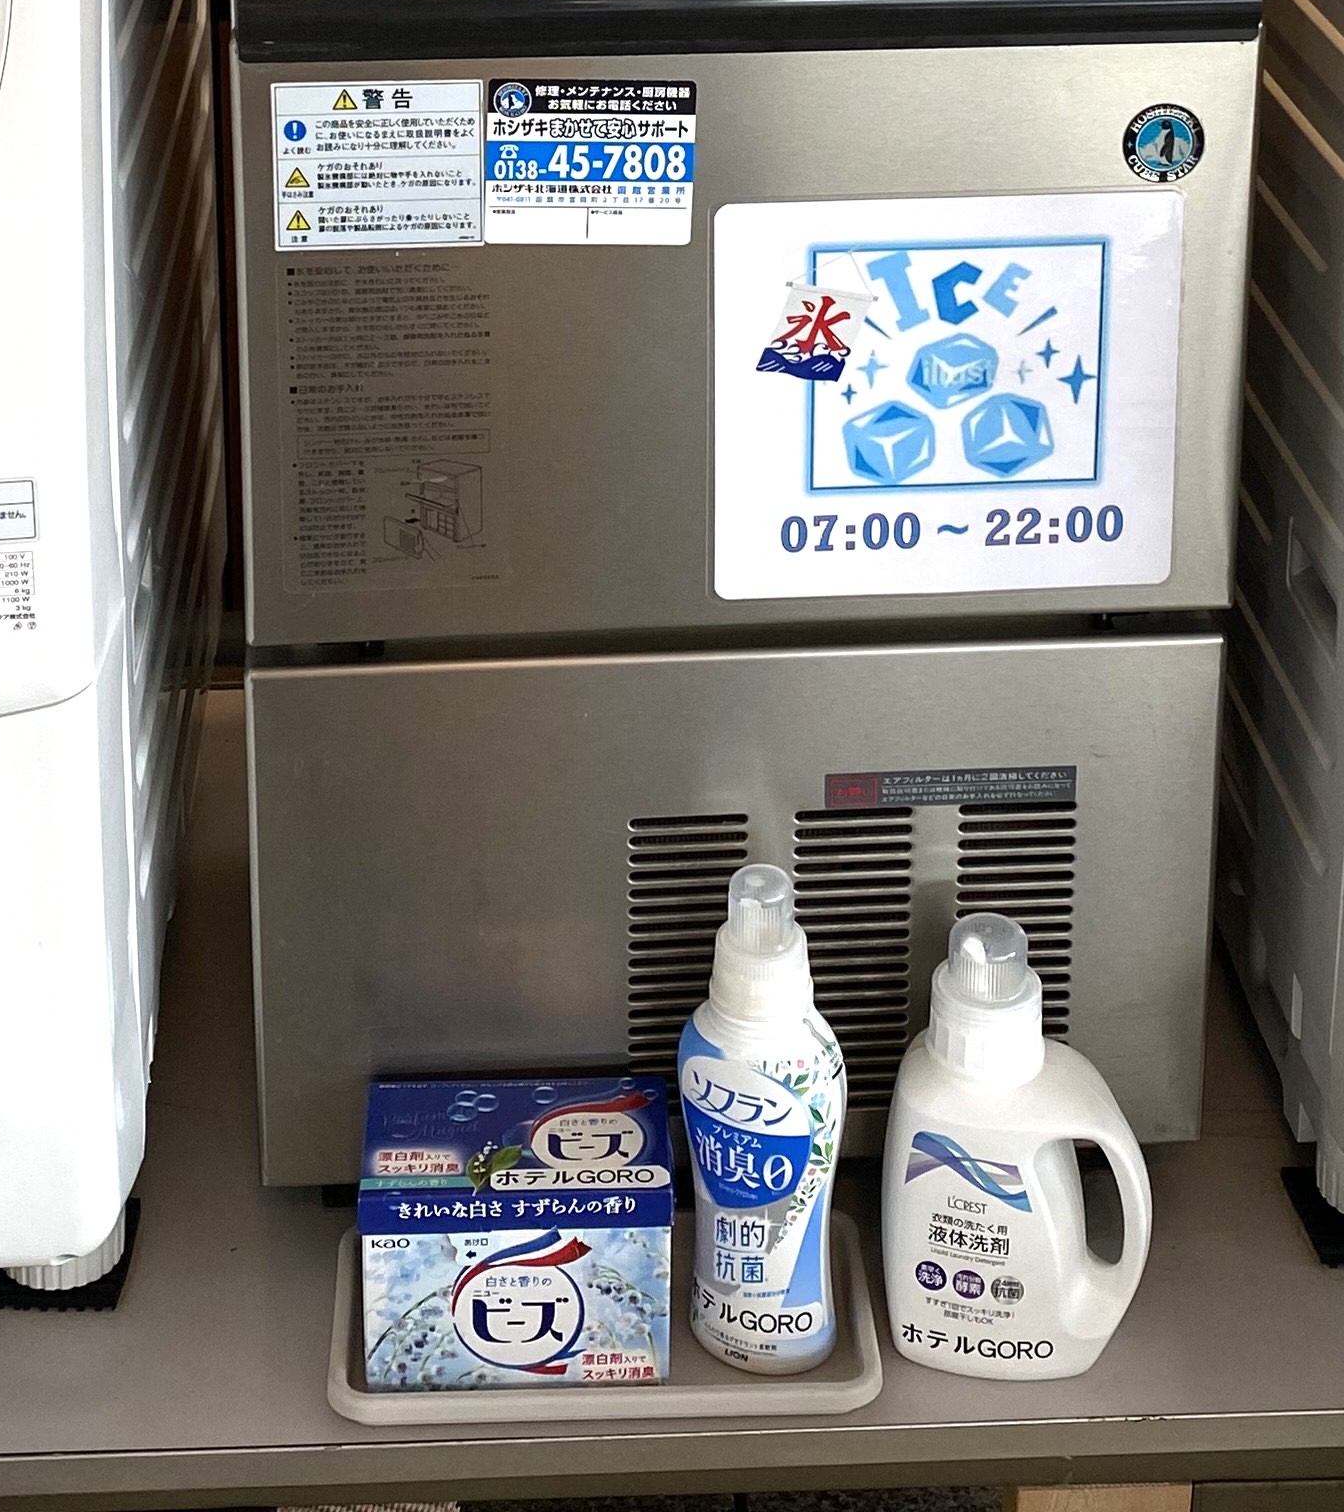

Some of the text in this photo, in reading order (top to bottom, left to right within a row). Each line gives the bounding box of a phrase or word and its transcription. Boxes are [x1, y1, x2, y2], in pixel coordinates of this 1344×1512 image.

[362, 88, 413, 110] 警告
[535, 86, 690, 98] 修理・メンテナンス・厨房機器
[548, 99, 677, 111] お気軽にお電話ください
[315, 118, 475, 129] この商品を安全に正しく使用していただくため
[493, 118, 689, 139] ホシザキまかせて安心サポート
[317, 162, 382, 171] ケガのおそれあり
[494, 144, 686, 180] 0138-45-7808
[492, 184, 612, 194] ホシザキ北海道株式会社
[318, 205, 383, 214] ケガのおそれあり
[865, 250, 1033, 332] ICE
[770, 296, 852, 354] 氷
[780, 504, 1124, 553] 07:00 22:00
[692, 1069, 792, 1127] ソフラン
[547, 1131, 633, 1161] ビーズ
[712, 1124, 762, 1149] プレミアム
[378, 1162, 460, 1174] スッキリ消臭
[496, 1169, 655, 1186] ホテルGORO
[398, 1196, 636, 1219] きれいな白さ すずらんの香り
[716, 1217, 765, 1248] 劇的
[932, 1213, 1008, 1236] 衣類の洗たく用
[928, 1223, 1009, 1255] 液体洗剤
[716, 1250, 764, 1283] 抗菌
[486, 1276, 552, 1287] 白さと香りの
[472, 1298, 568, 1344] ビーズ
[902, 1324, 1054, 1360] ホテルGORO
[724, 1349, 748, 1362] LION
[582, 1366, 655, 1380] スッキリ消臭
